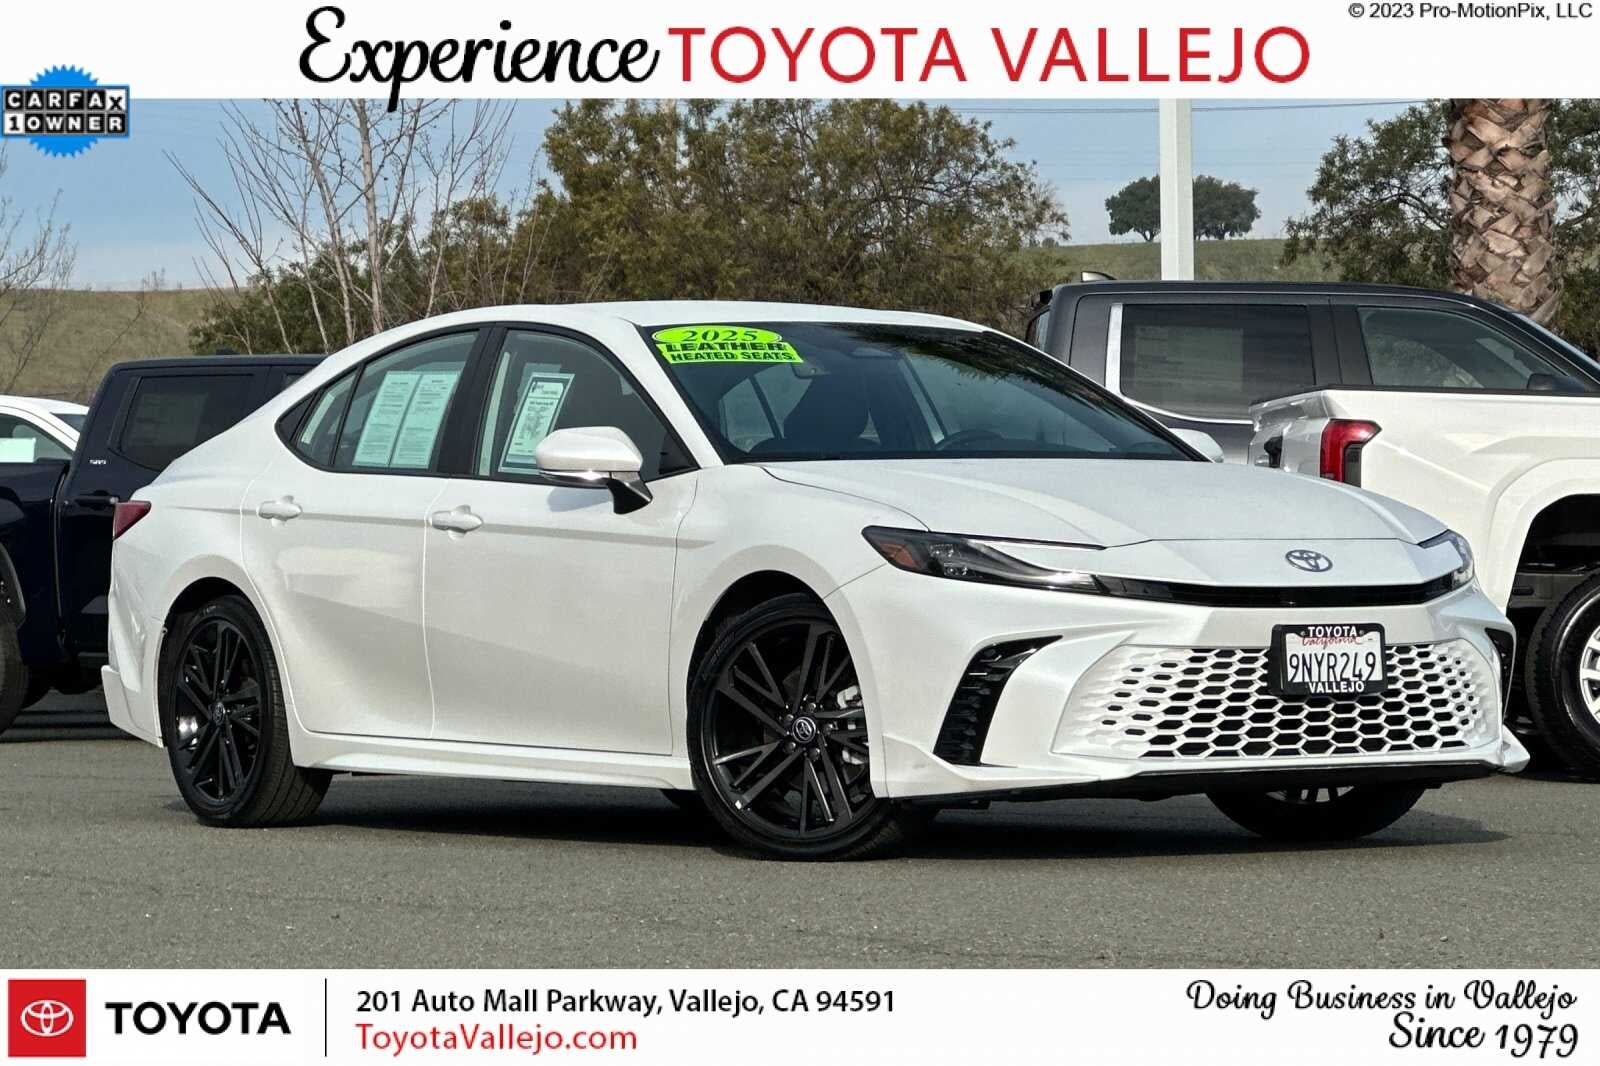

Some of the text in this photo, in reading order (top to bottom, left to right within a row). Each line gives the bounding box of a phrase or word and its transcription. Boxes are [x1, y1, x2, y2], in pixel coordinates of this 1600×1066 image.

[682, 330, 758, 341] 2025
[665, 342, 785, 352] LEATHER
[670, 351, 795, 362] HEATED SEATS
[1308, 626, 1357, 637] TOYOTA
[1289, 652, 1376, 682] 9NYR249
[1308, 681, 1365, 693] VALLEJO
